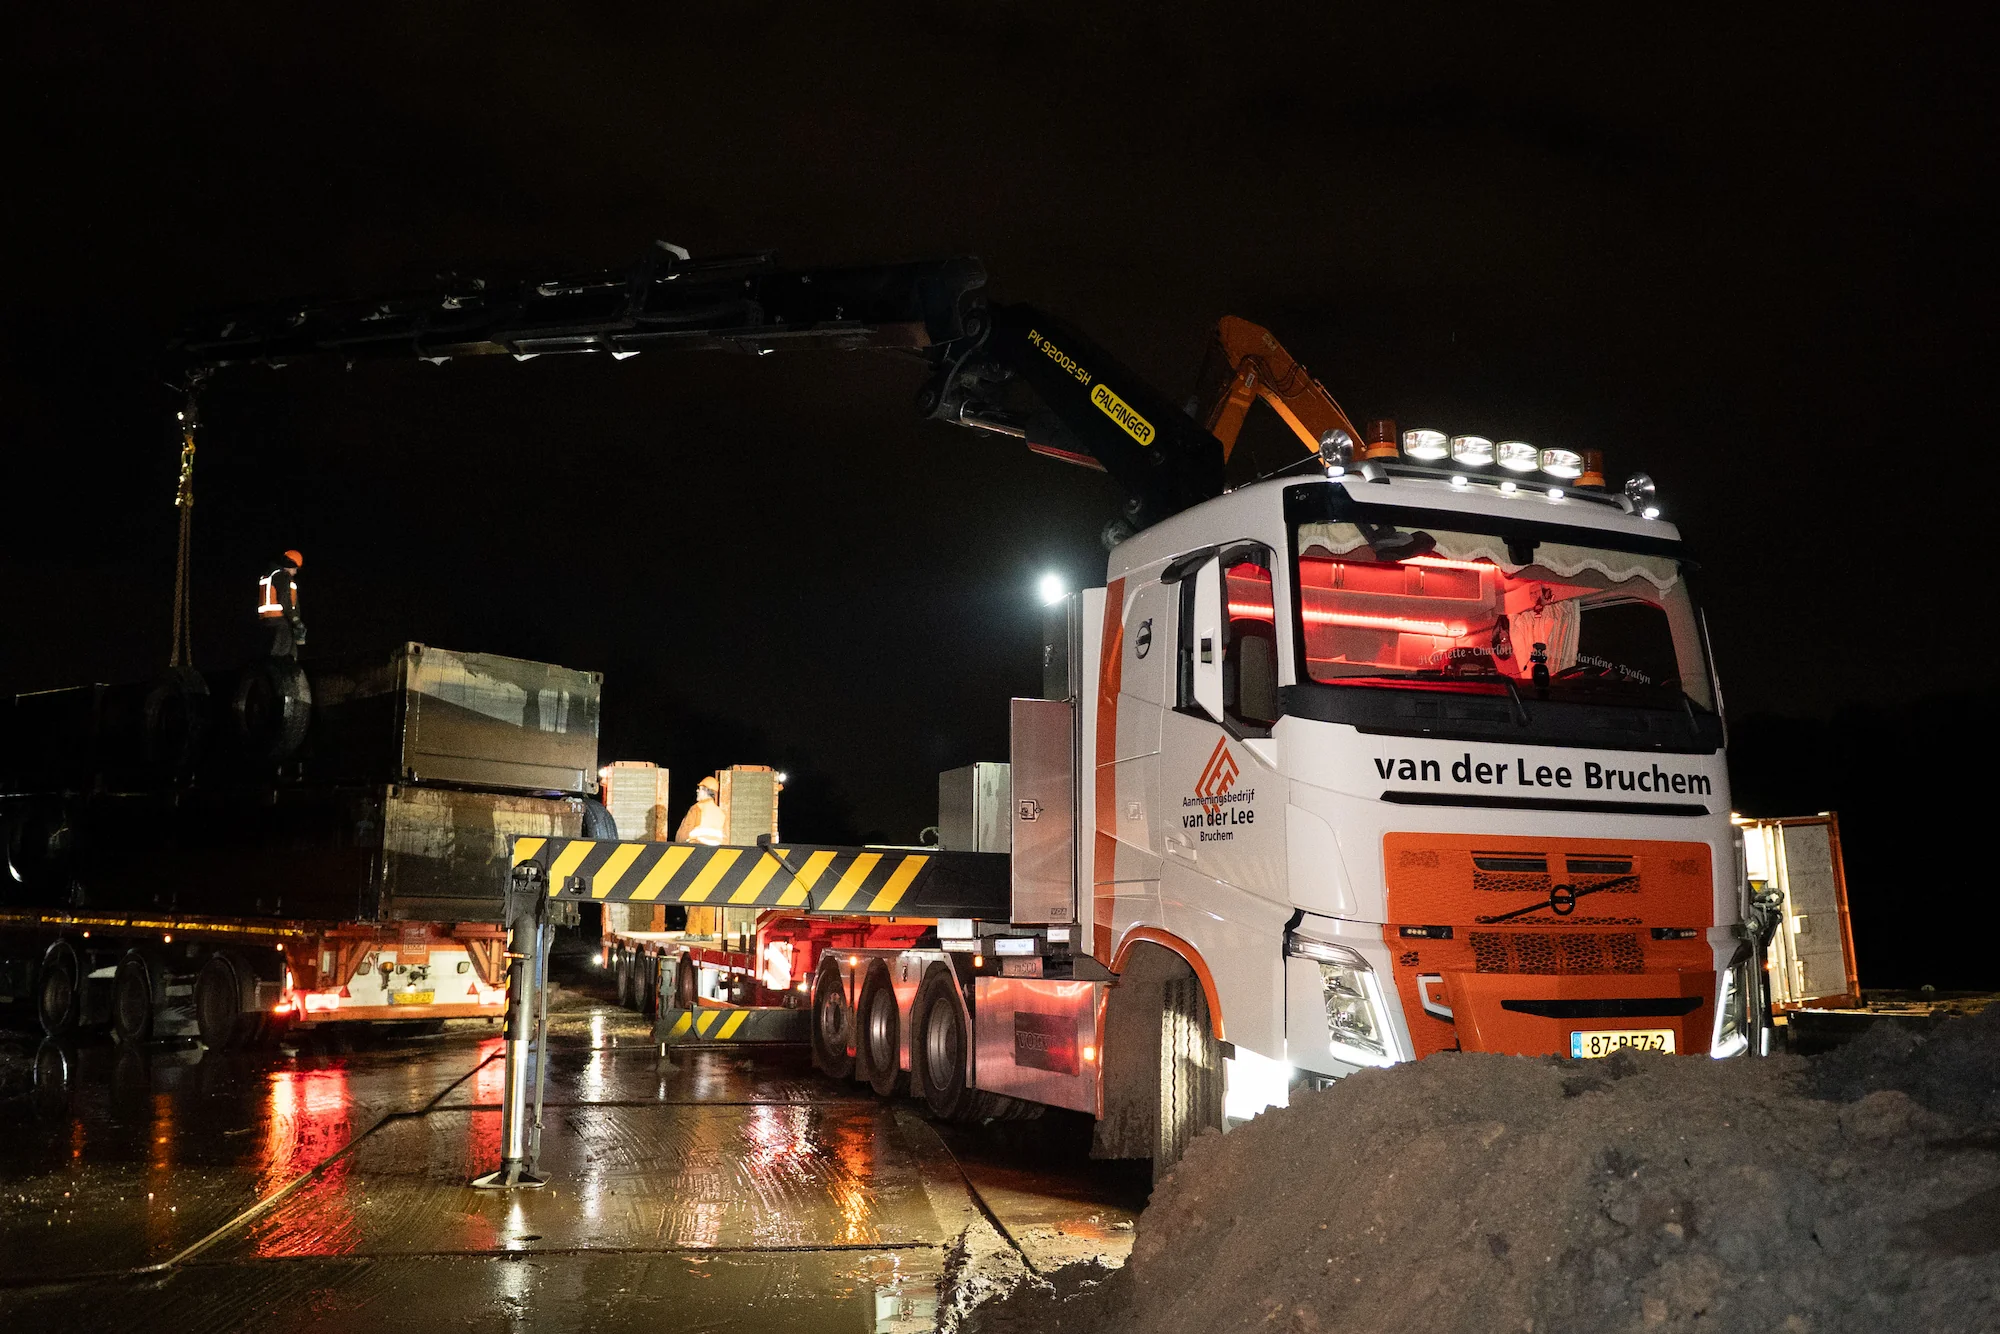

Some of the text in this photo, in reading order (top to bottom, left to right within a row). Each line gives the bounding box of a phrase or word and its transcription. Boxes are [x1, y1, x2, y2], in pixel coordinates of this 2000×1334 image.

[1028, 329, 1092, 386] PK 92002-SH
[1095, 388, 1151, 442] PALFINGER
[1374, 753, 1712, 796] van der Lee Bruchem
[1182, 789, 1255, 807] Aannemingsbedrijf
[1182, 807, 1255, 828] van der Lee
[1200, 829, 1234, 842] Bruchem
